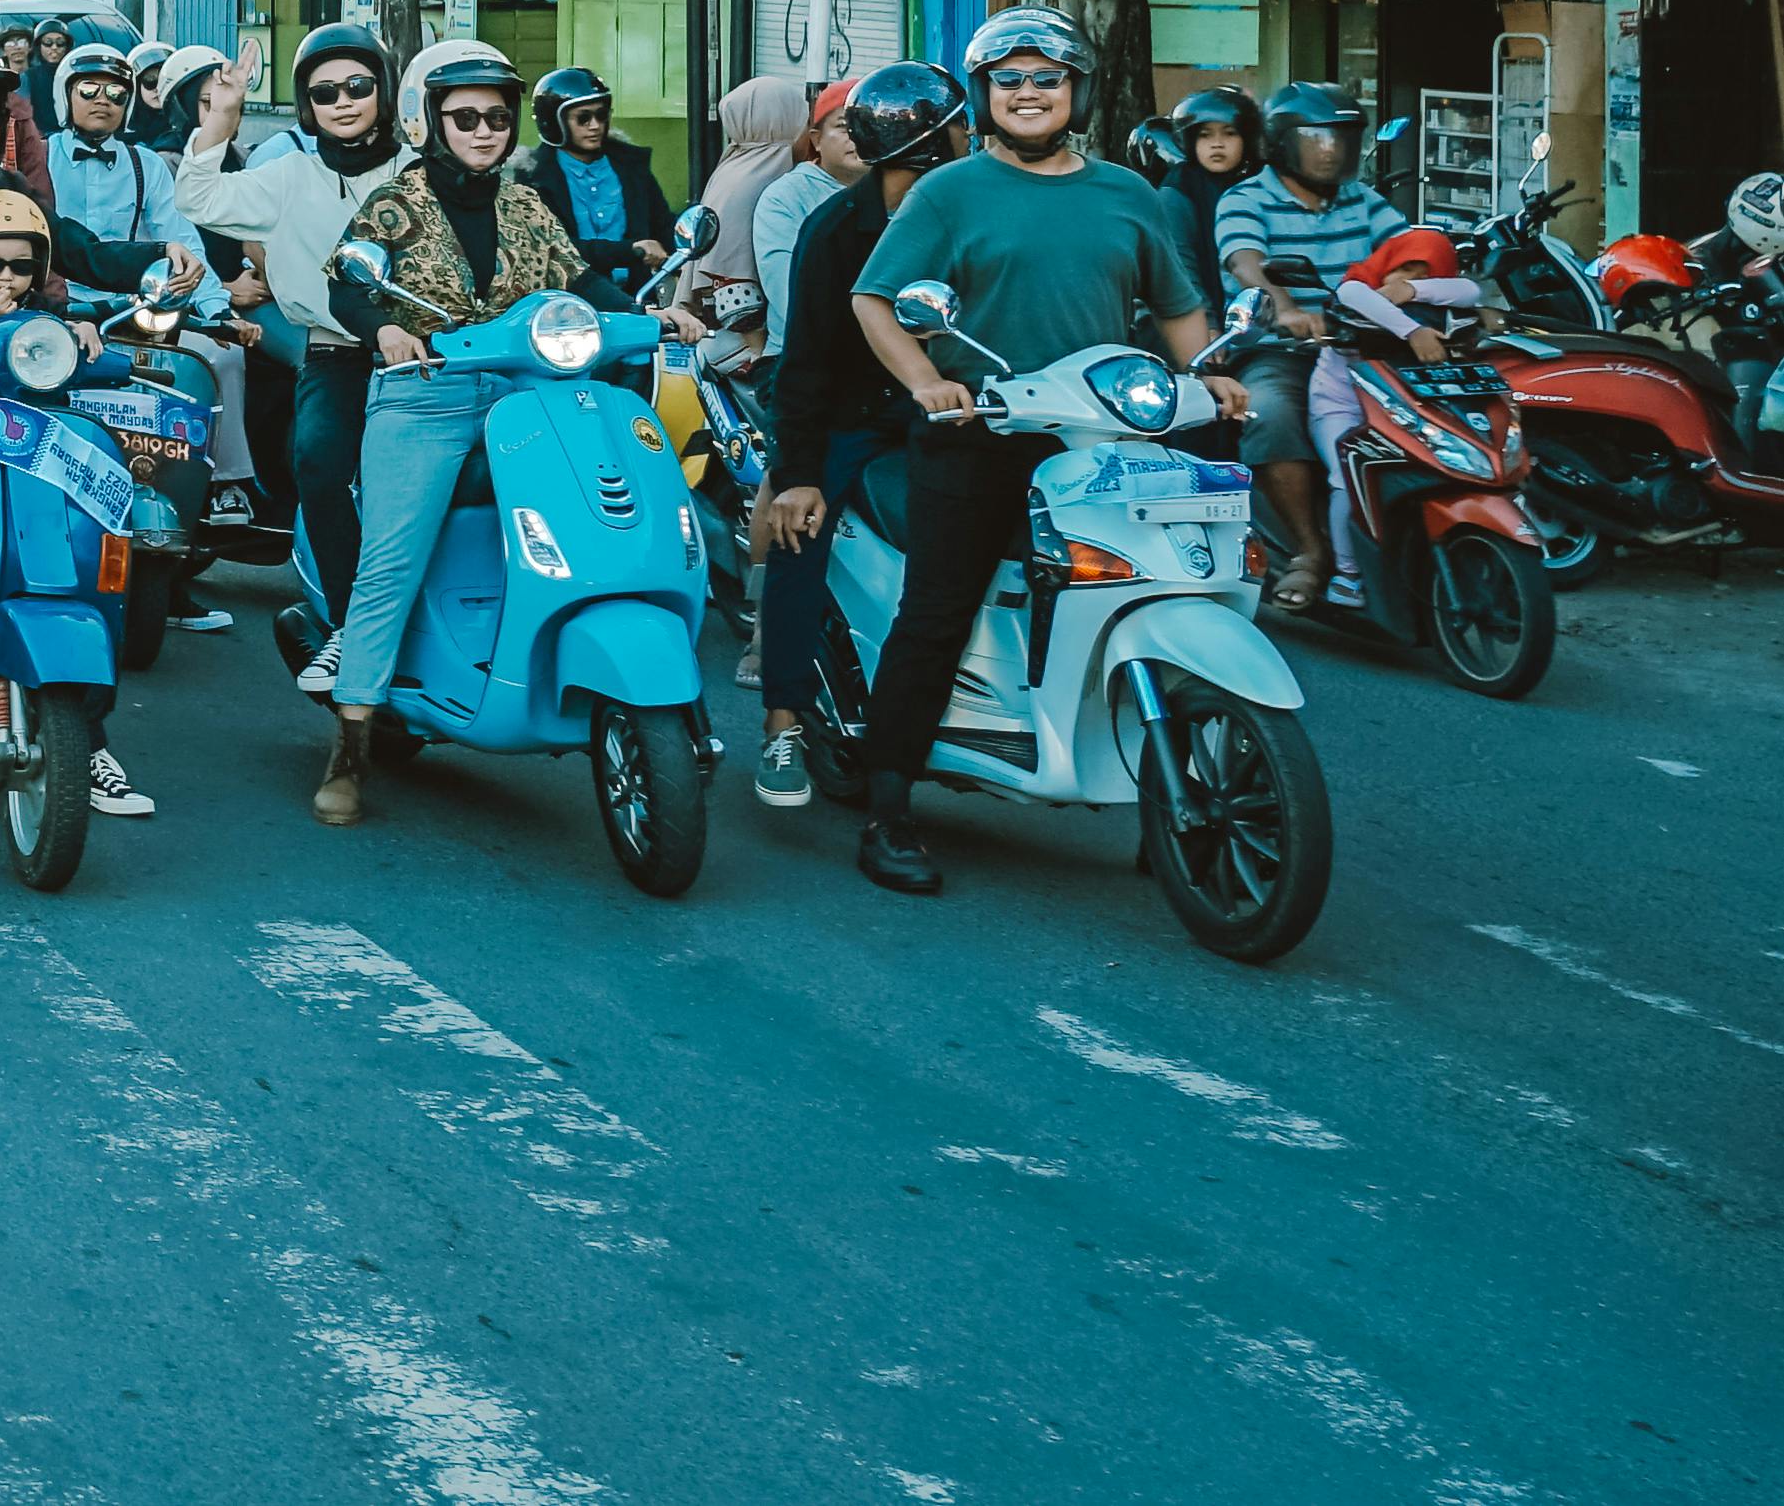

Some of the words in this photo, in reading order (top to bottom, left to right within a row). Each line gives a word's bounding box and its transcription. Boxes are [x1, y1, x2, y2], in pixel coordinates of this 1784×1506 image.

[108, 415, 154, 429] MAYDAY
[49, 443, 97, 483] MAYDAY
[1126, 460, 1187, 476] MAYDAY
[64, 467, 124, 521] BANGKALAN
[97, 479, 129, 509] MODS
[105, 470, 133, 499] 2023
[1084, 477, 1122, 495] 2023
